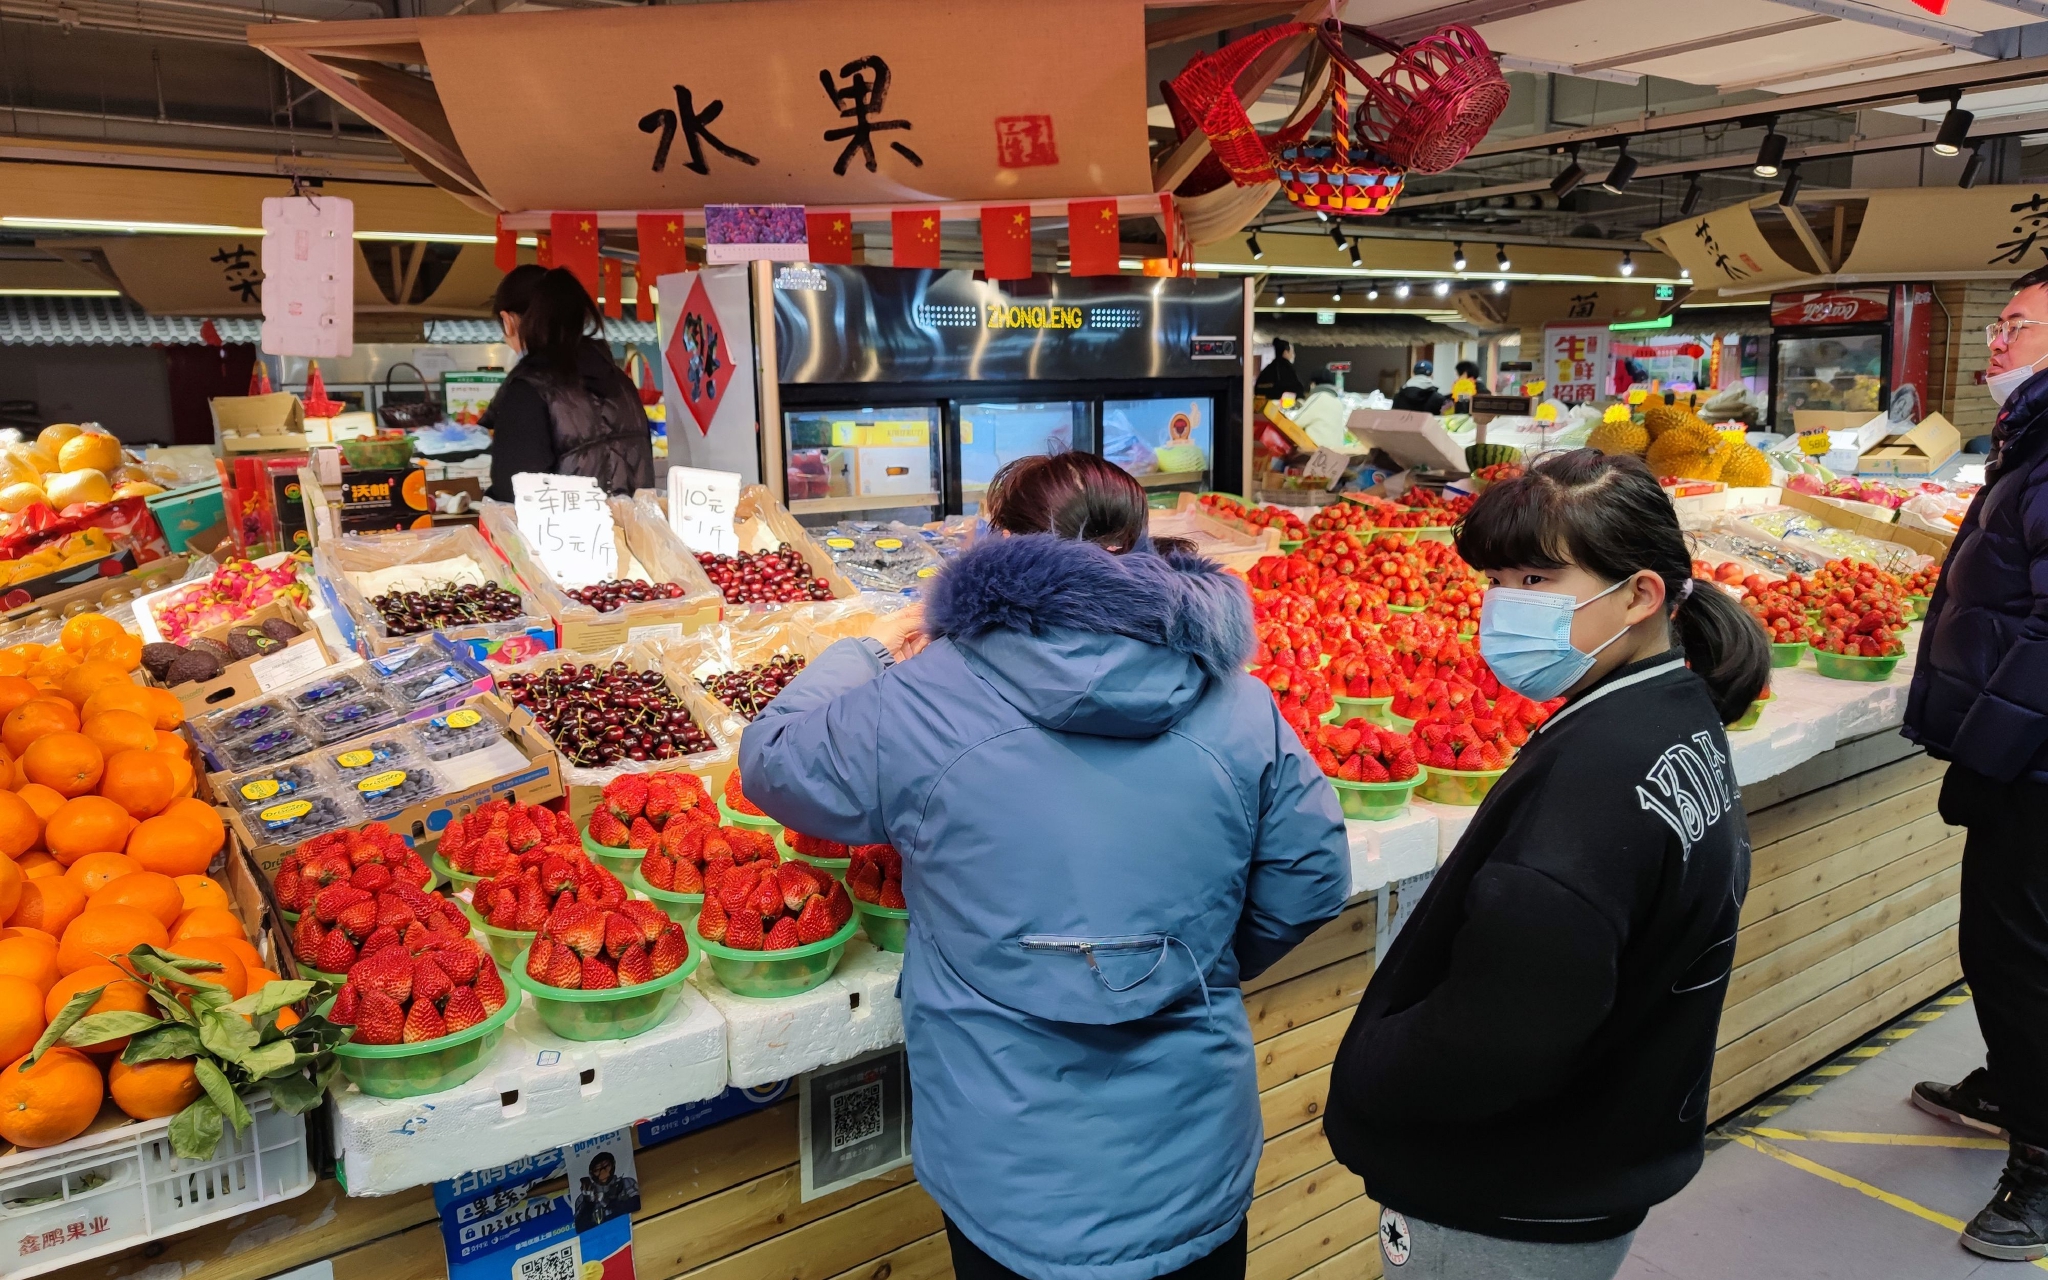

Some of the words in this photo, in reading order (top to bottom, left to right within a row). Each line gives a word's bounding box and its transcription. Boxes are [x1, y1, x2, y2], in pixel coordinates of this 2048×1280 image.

[637, 55, 924, 177] 水果
[986, 305, 1083, 329] ZHONGLENG
[1553, 383, 1596, 402] 招商
[350, 483, 390, 498] 沃柑
[534, 486, 606, 515] 车厘子
[684, 489, 726, 515] 10元
[698, 521, 726, 552] 1斤
[18, 1216, 110, 1257] 鑫鹏果业
